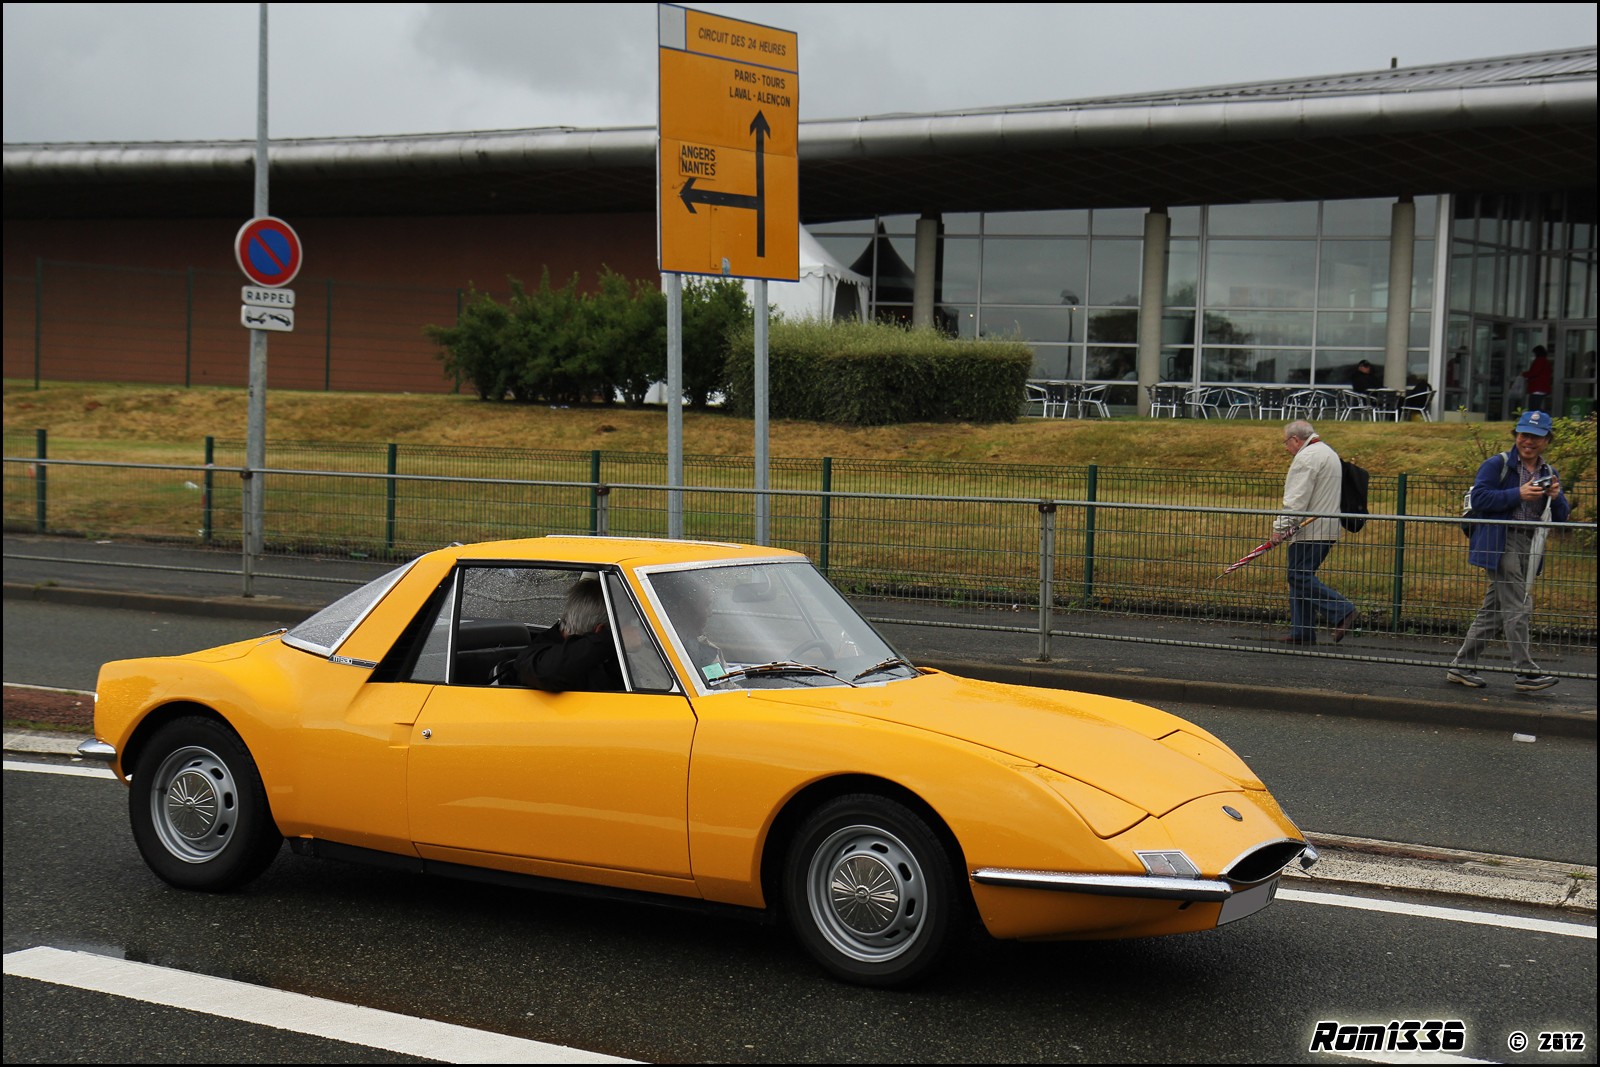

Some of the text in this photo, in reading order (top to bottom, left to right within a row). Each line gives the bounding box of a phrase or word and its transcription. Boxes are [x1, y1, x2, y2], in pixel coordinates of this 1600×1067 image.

[698, 27, 786, 56] CIRCUIT DES 24 HEURES
[681, 144, 716, 161] ANGERS
[681, 159, 716, 176] NANTES
[247, 291, 292, 304] RAPPEL
